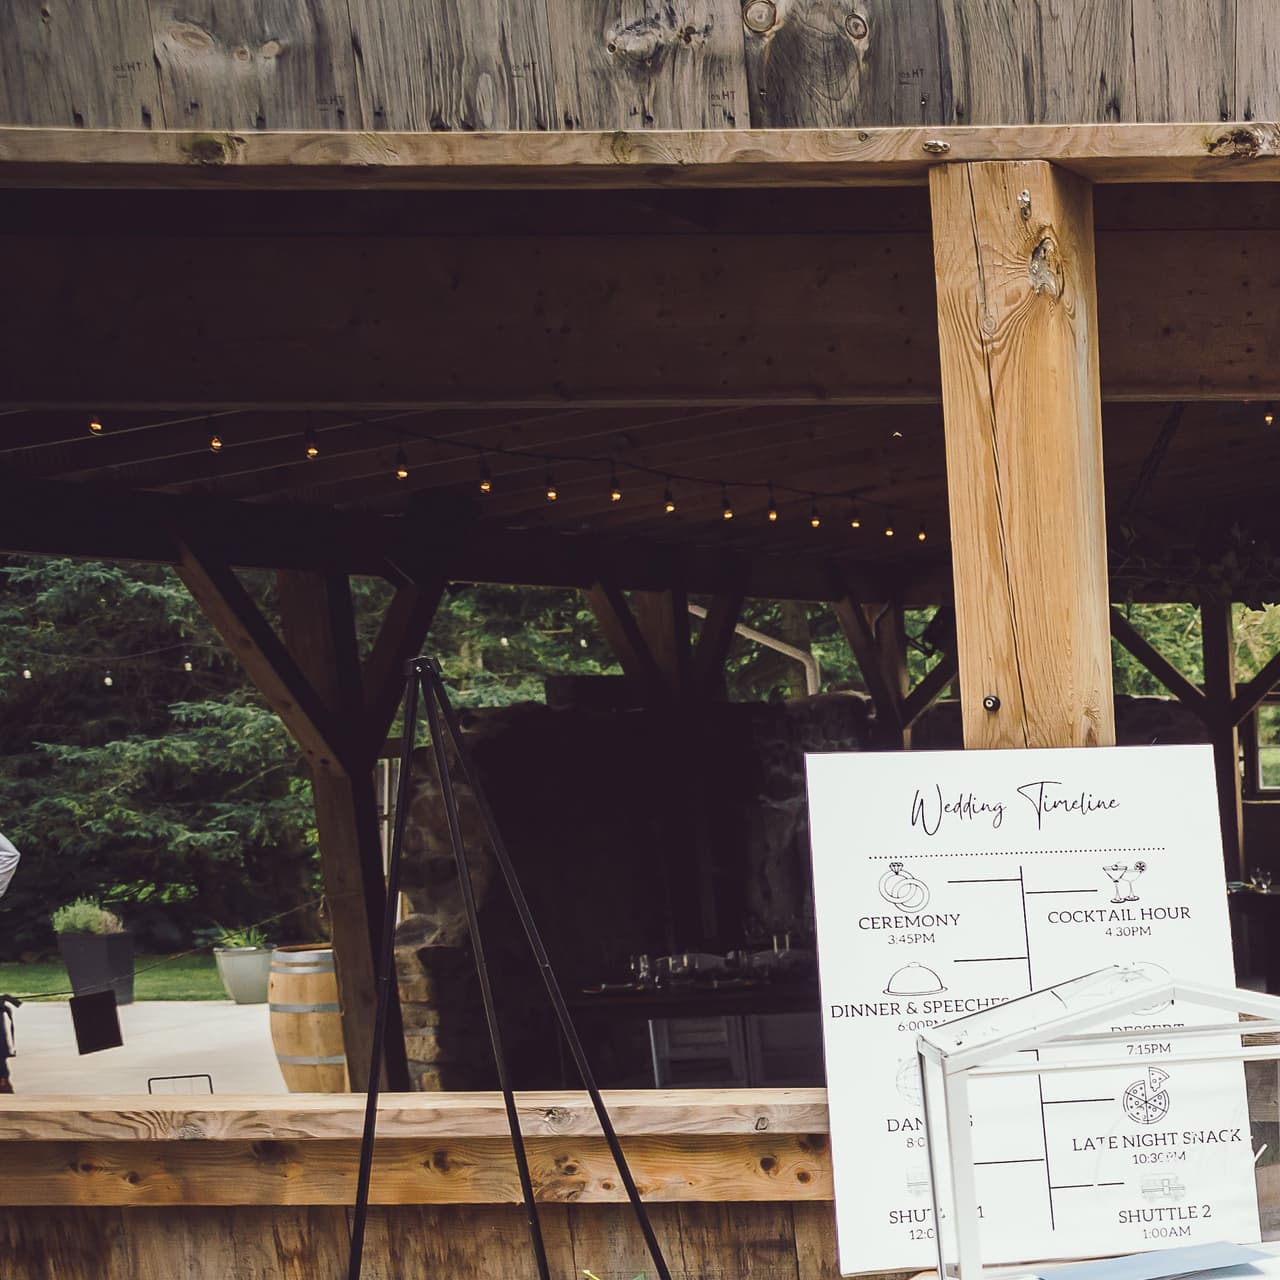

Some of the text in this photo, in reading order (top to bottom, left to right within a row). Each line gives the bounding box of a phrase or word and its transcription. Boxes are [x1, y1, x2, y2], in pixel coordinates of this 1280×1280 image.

[911, 781, 1120, 836] Wedding Timeline
[858, 913, 961, 930] CEREMONY
[1048, 906, 1192, 924] COCKTAIL HOUR
[887, 932, 936, 945] 3:45PM
[831, 997, 1009, 1019] DINNER & SPEECH
[897, 1018, 947, 1032] 6:00P
[1126, 1042, 1172, 1056] 7:15PM
[1072, 1128, 1242, 1152] LATE NIGHT SNACK
[1118, 1204, 1212, 1224] SHUTTLE 2
[1143, 1225, 1192, 1240] 1:00AM
